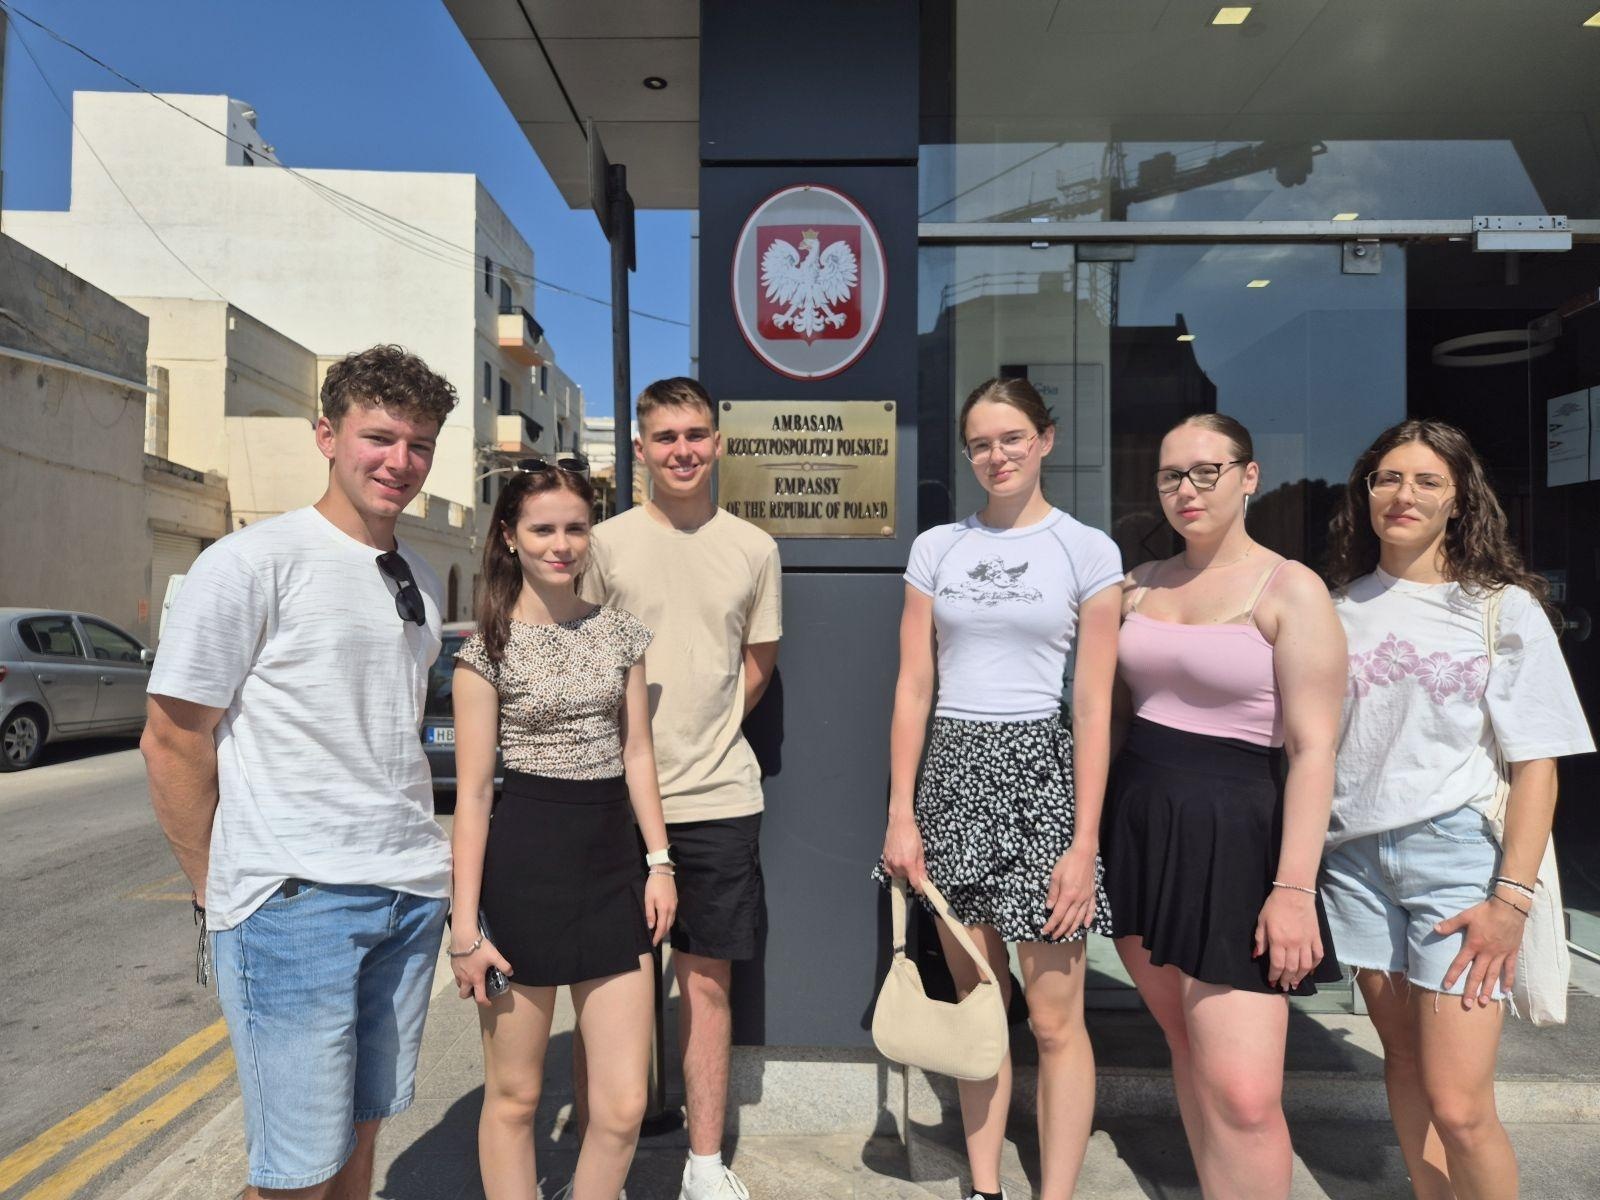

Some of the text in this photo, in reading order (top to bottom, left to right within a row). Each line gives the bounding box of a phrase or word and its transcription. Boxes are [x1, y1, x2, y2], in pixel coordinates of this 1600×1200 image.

[772, 414, 843, 432] AMBASADA
[727, 437, 888, 456] RZECZYPOSPOLITEJ POLSKIEJ
[775, 477, 841, 495] EMBASSY
[726, 501, 887, 519] OF THE REPUBLIC OF POLAND
